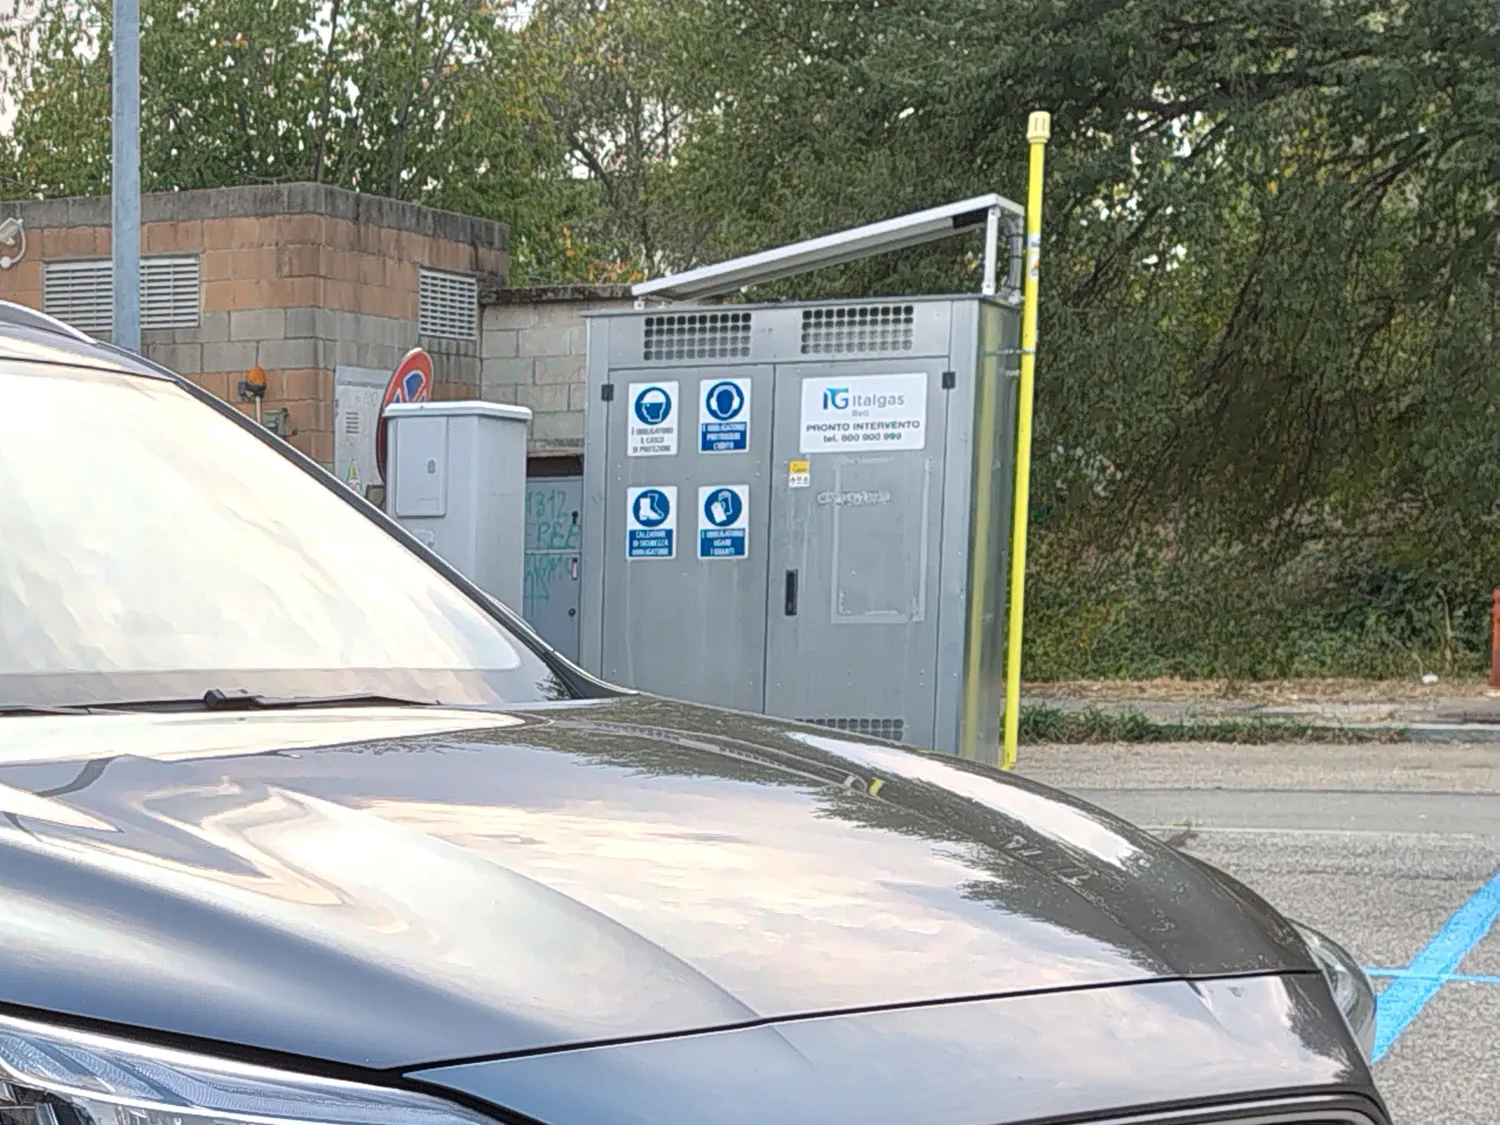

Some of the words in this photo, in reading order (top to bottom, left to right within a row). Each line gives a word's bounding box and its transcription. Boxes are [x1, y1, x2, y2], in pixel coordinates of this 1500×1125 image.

[852, 393, 905, 409] Italgas
[806, 422, 850, 432] PRONTO
[853, 420, 921, 431] INTERVENTO
